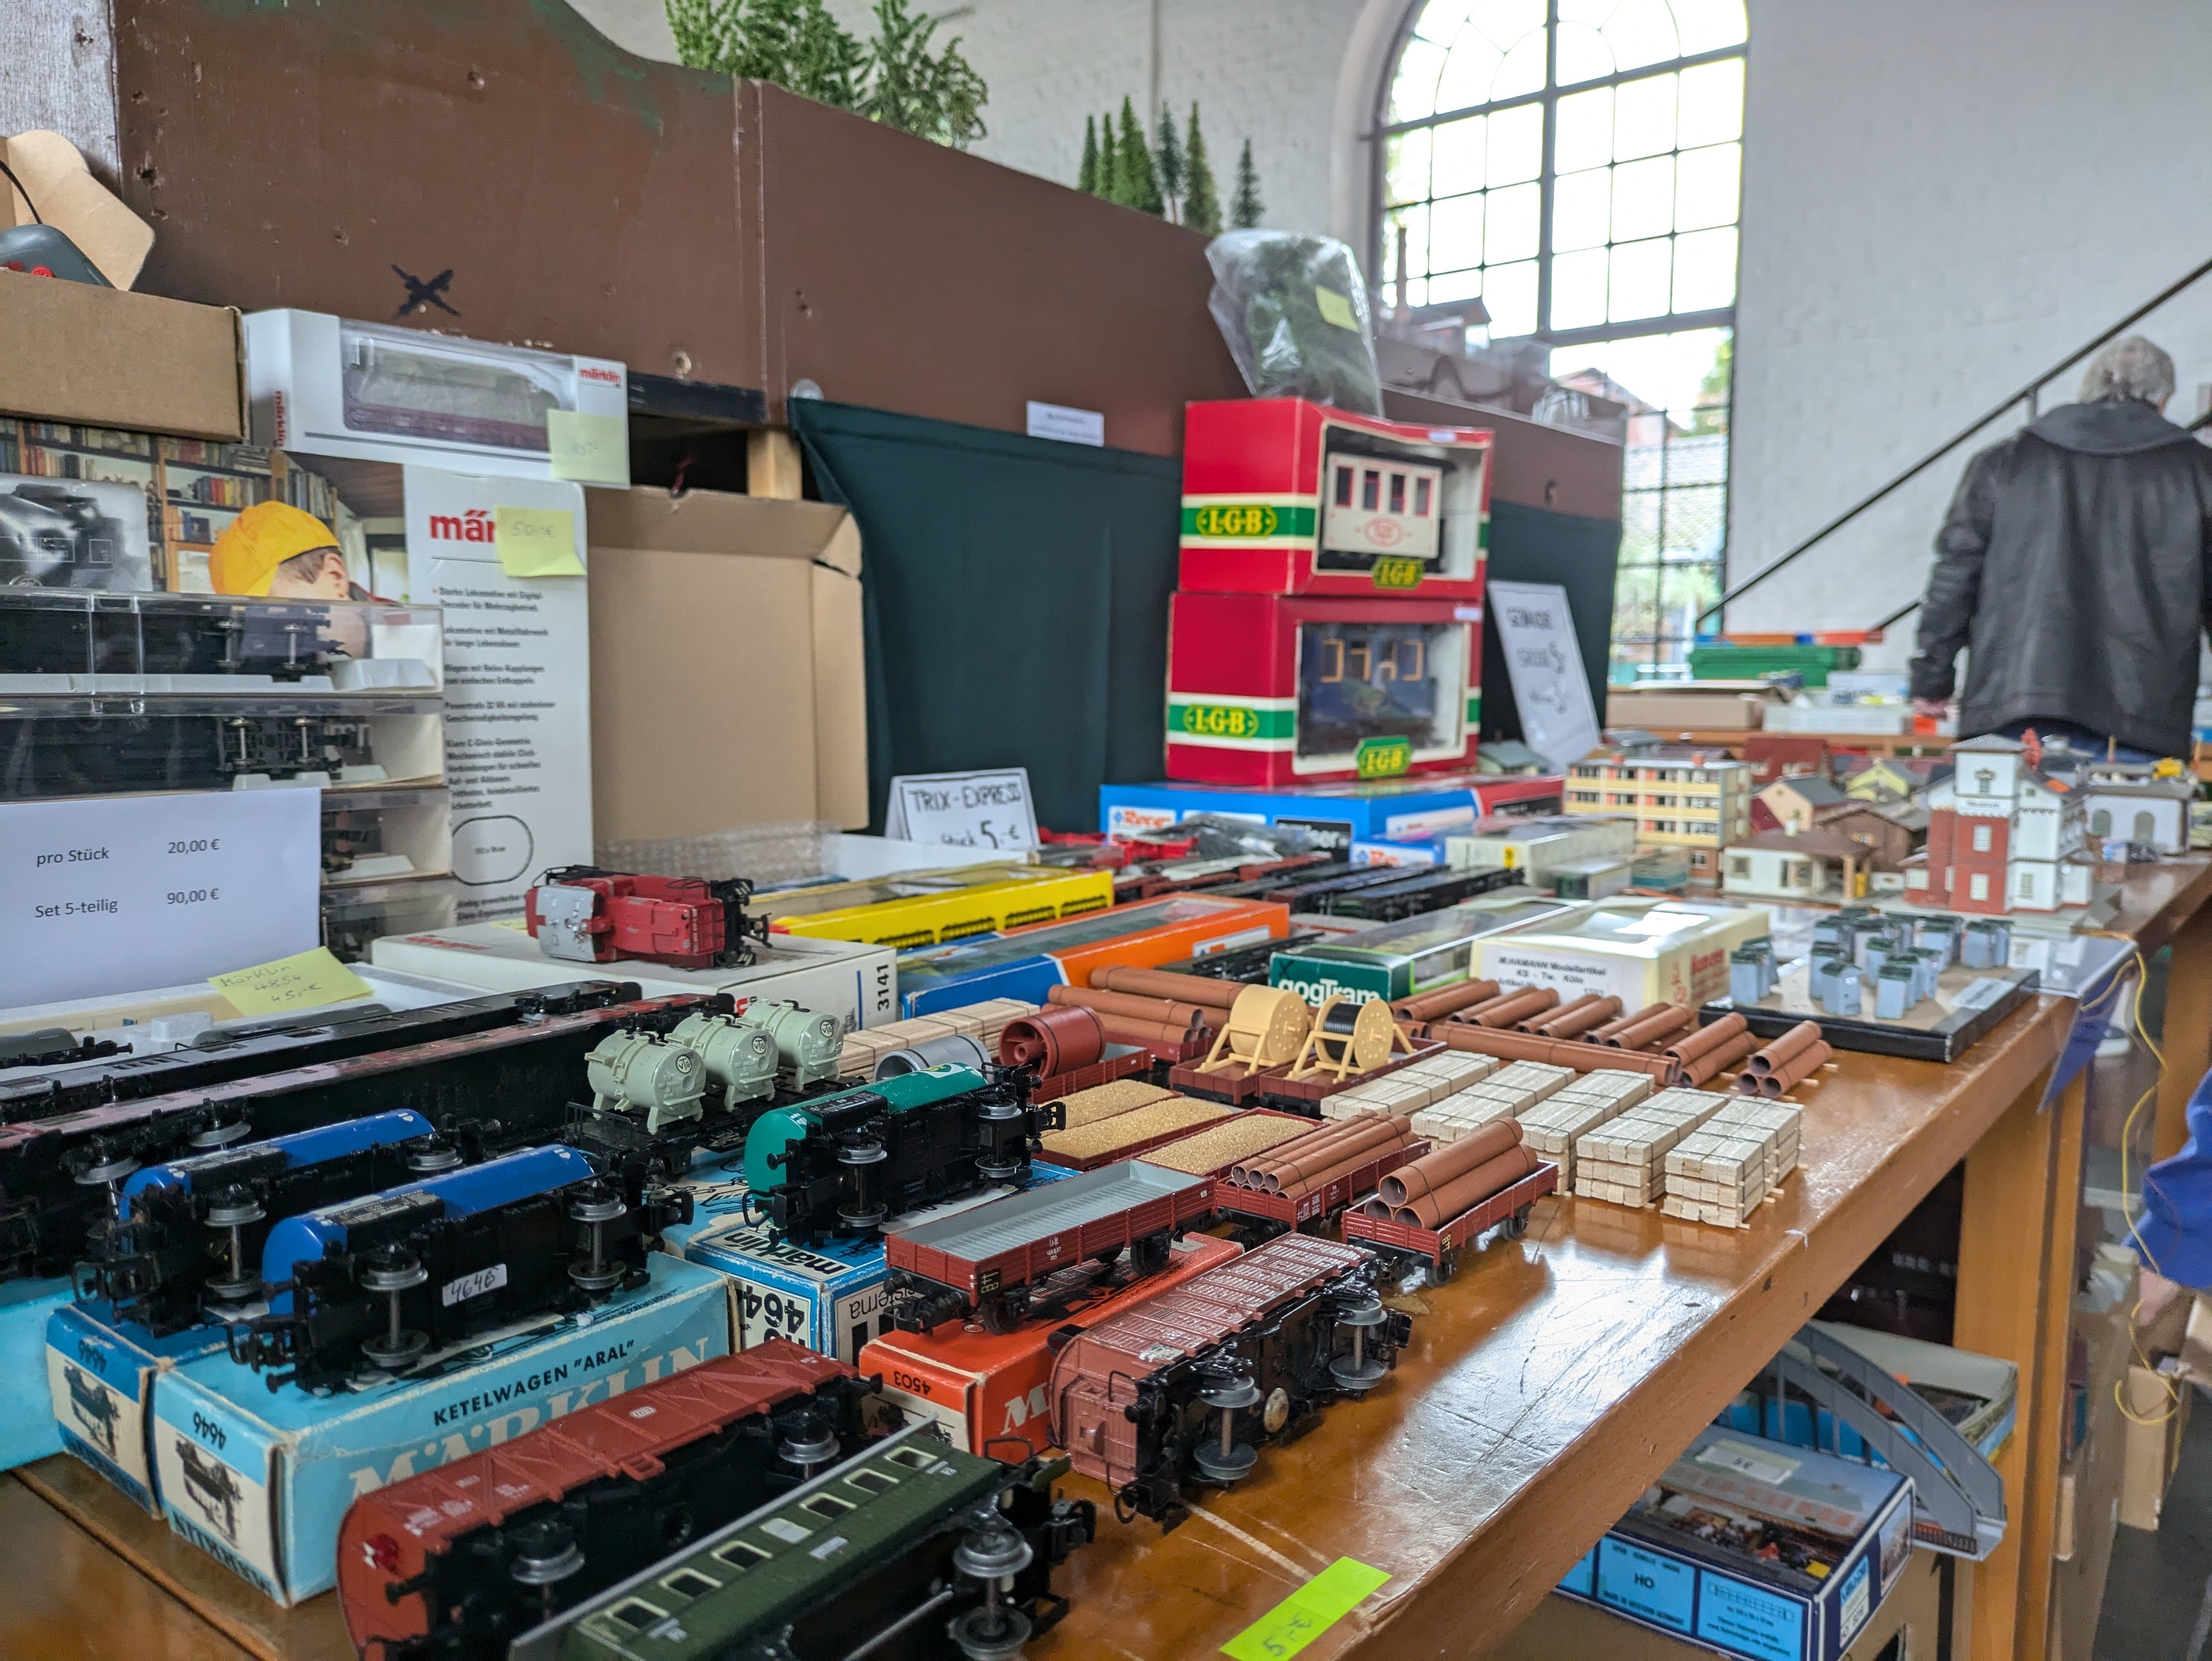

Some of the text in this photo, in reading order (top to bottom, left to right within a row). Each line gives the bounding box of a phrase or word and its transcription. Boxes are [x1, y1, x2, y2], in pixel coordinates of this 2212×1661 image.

[429, 508, 497, 544] mär
[1195, 711, 1247, 735] LGB
[37, 839, 220, 867] pro Stück 20,00 €
[35, 888, 220, 918] Set 5-teilig 90,00 €
[876, 964, 889, 1012] 3141
[821, 1022, 833, 1037] VTG
[754, 1040, 766, 1053] VTG
[678, 1057, 690, 1070] VTG
[723, 1231, 848, 1275] märklin
[736, 1285, 805, 1335] 464
[433, 1339, 635, 1427] KETELWAGEN "ARAL"
[893, 1370, 932, 1395] 4503
[193, 1412, 226, 1451] 4646
